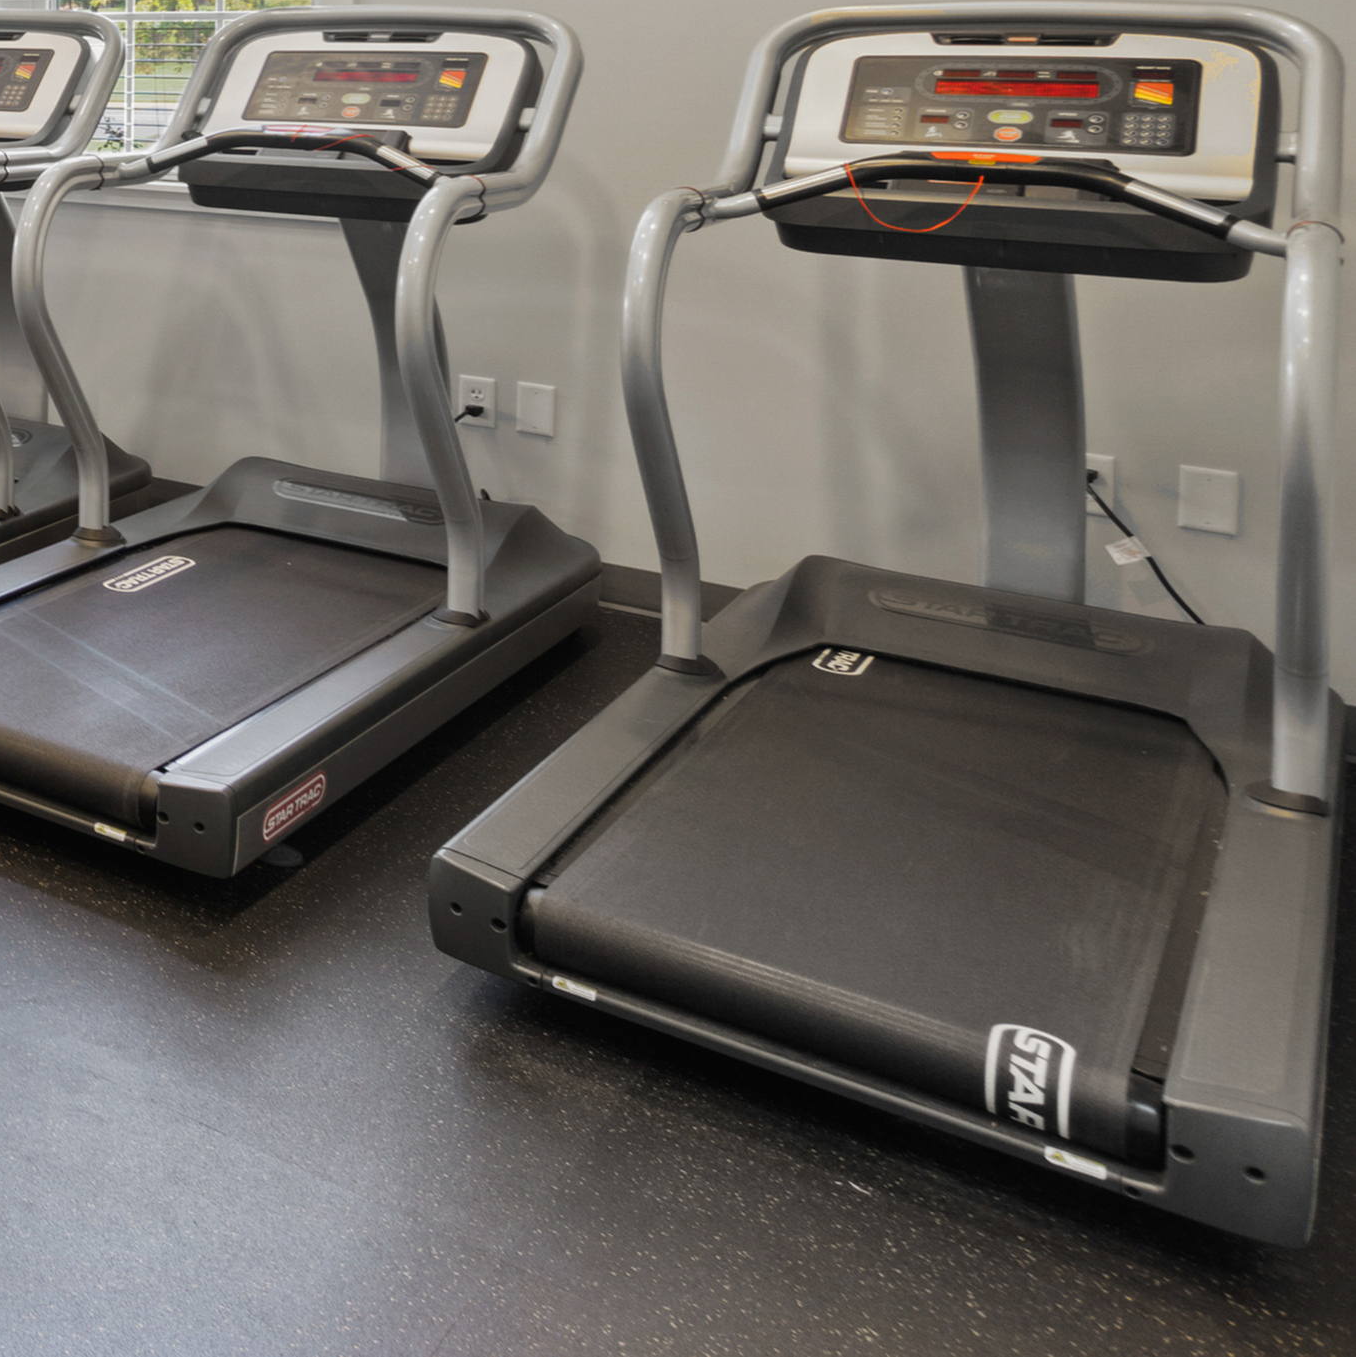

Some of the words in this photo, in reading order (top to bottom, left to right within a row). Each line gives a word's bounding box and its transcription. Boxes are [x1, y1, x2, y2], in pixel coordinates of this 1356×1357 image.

[114, 569, 157, 590] TRAC
[149, 557, 186, 576] STAR
[880, 593, 993, 624] STAR
[265, 802, 295, 832] STAR
[294, 782, 323, 812] TRAC
